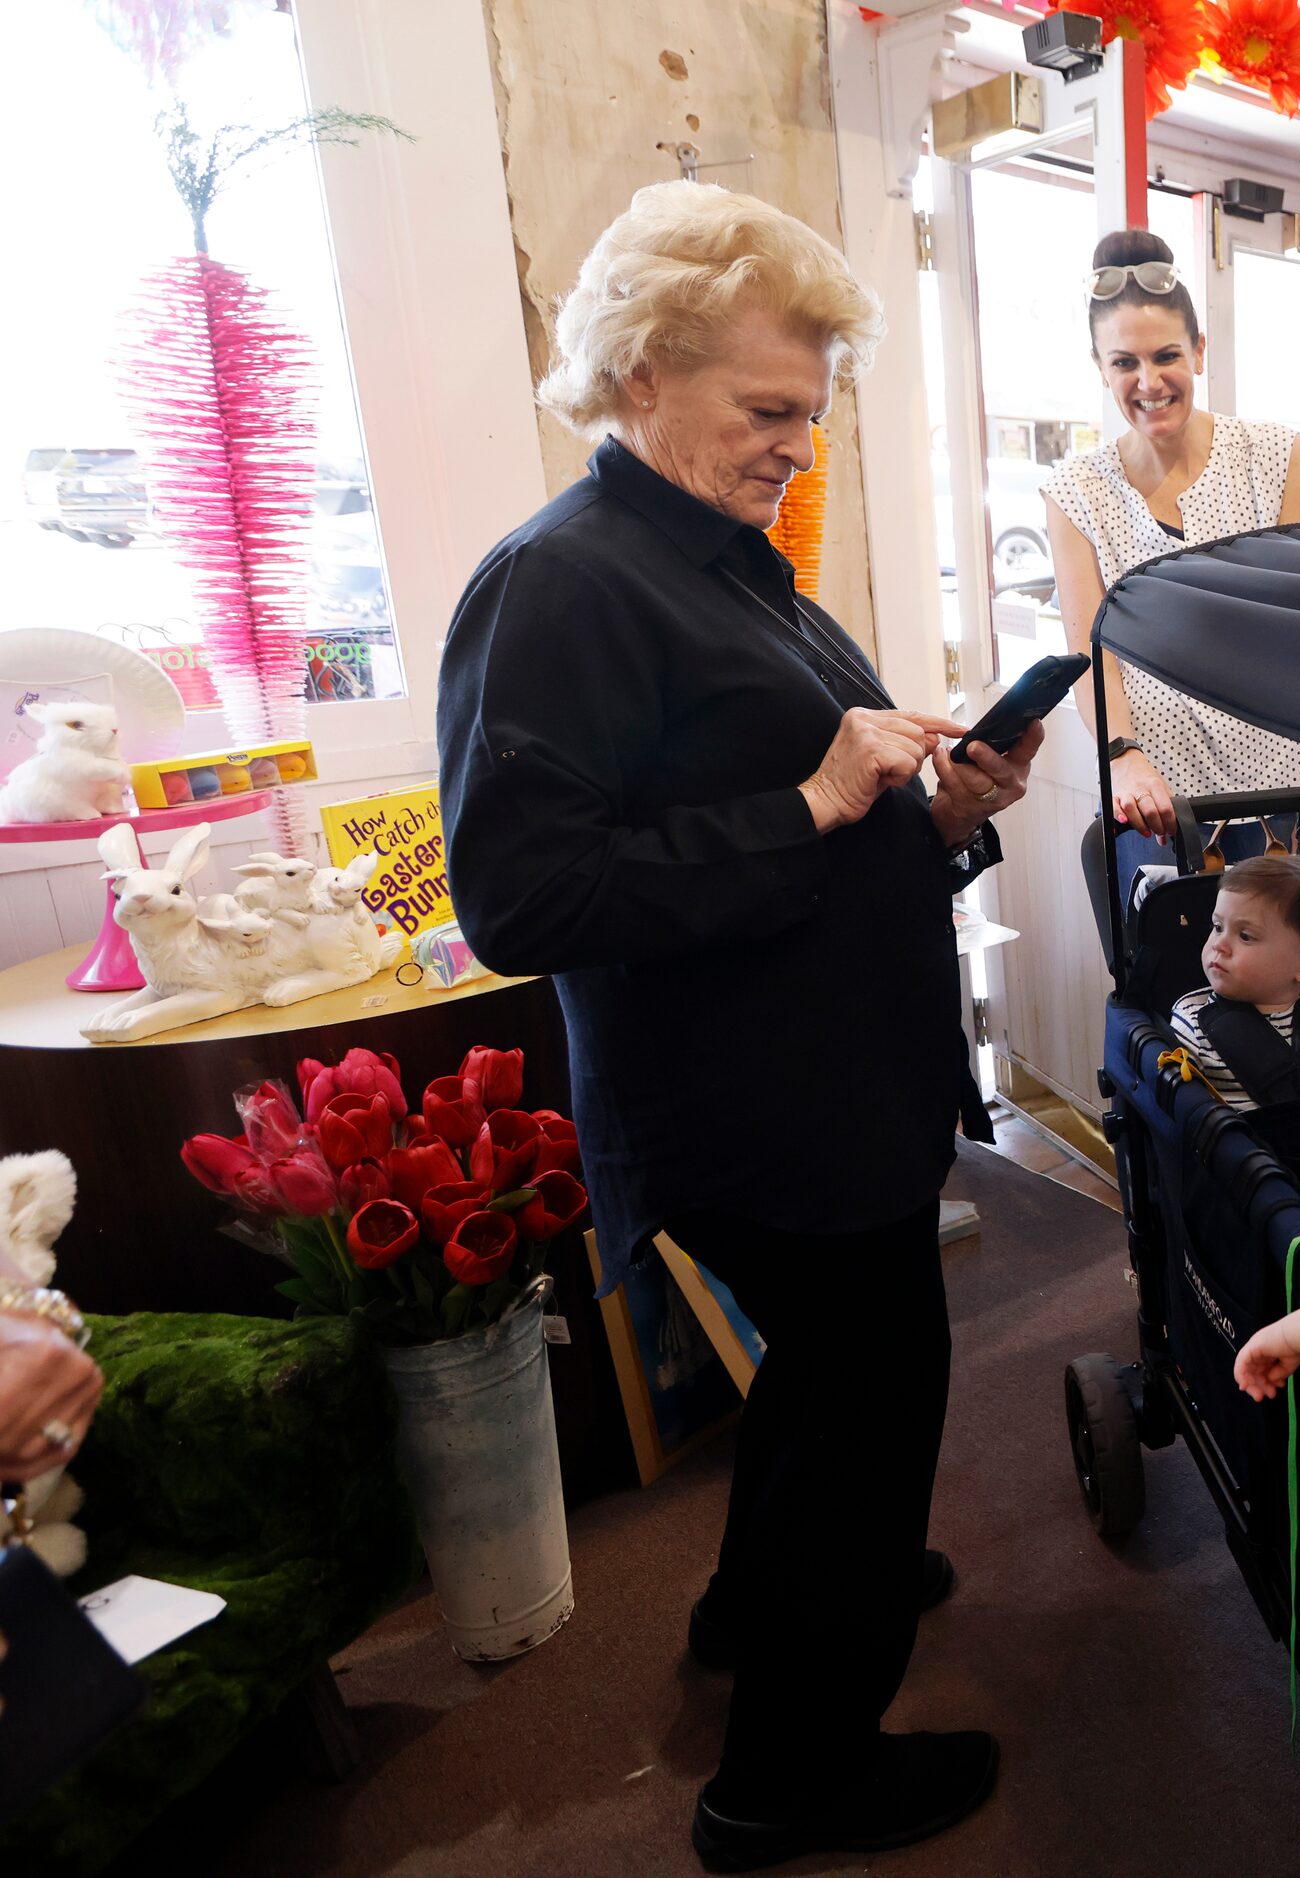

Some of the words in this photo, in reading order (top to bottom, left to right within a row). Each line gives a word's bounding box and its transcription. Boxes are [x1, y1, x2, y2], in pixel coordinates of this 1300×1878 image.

[341, 809, 387, 848] How
[373, 807, 426, 856] Catch
[425, 800, 441, 820] th
[361, 835, 443, 913] Easter
[386, 864, 450, 936] Bunn
